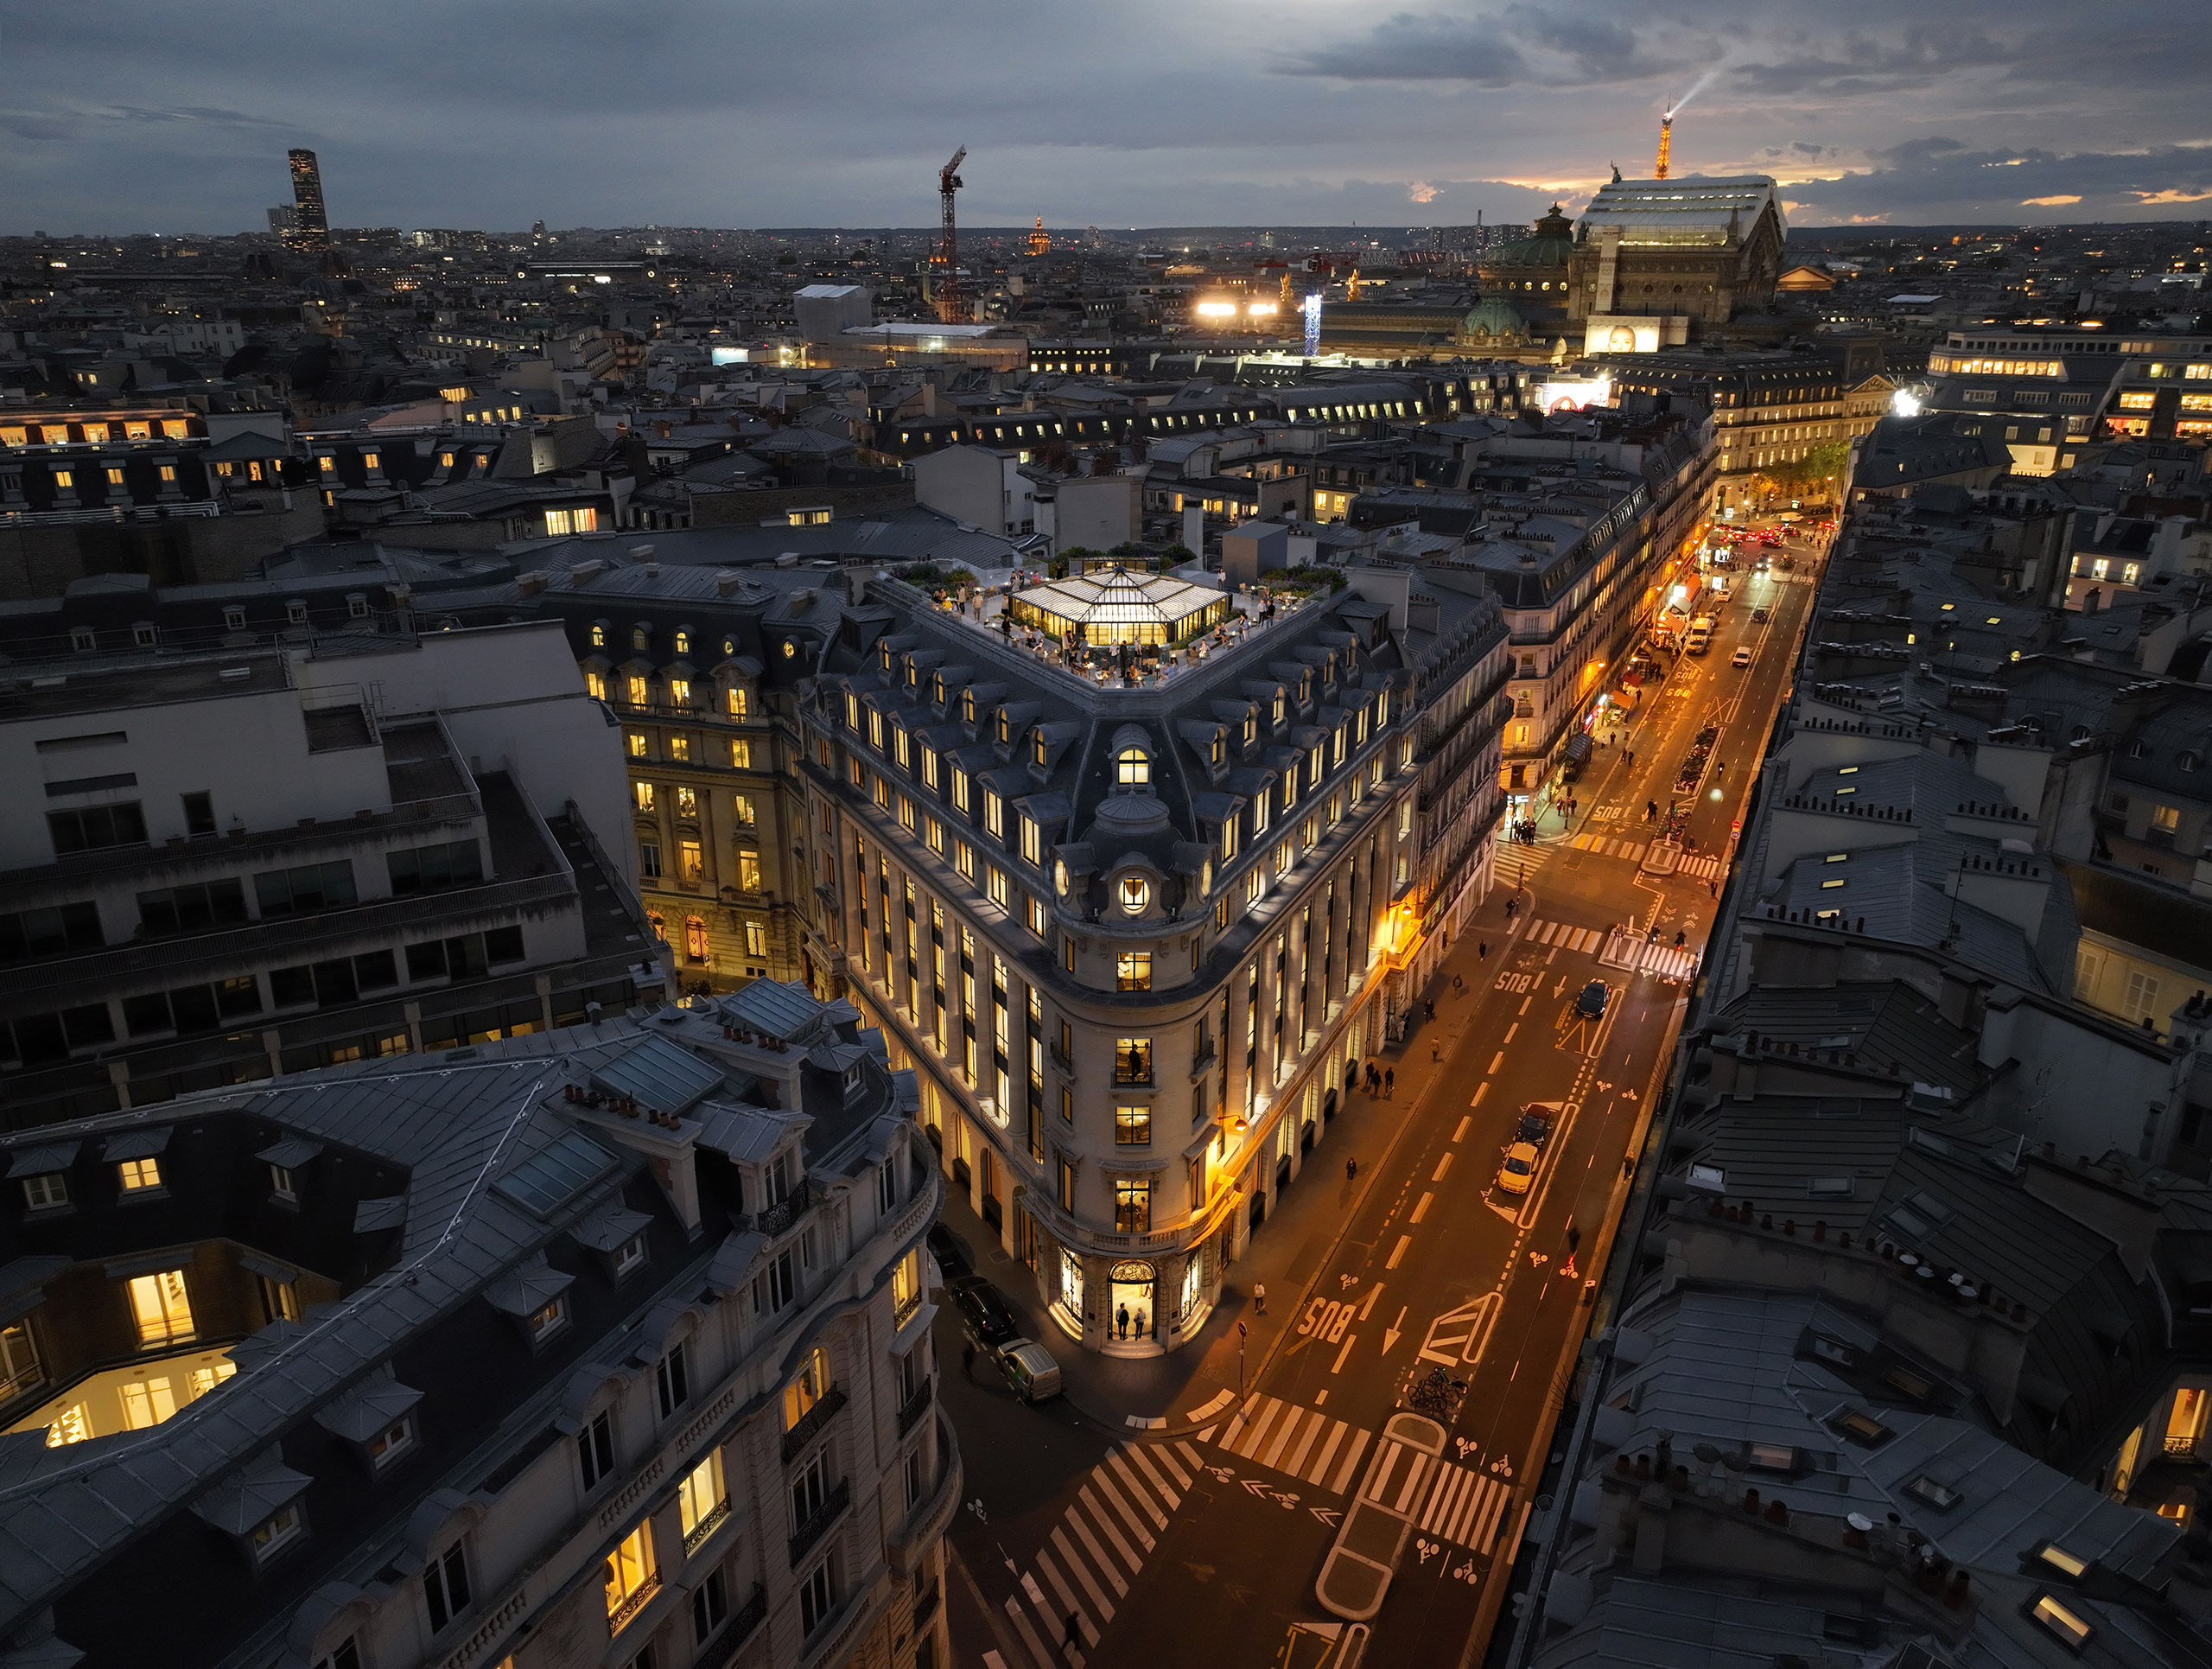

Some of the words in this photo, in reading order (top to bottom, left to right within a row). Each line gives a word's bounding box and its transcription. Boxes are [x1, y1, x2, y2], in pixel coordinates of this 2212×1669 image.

[1675, 671, 1696, 680] BUS
[1666, 688, 1691, 698] BUS
[1593, 806, 1622, 819] BUS
[1494, 971, 1532, 994] BUS
[1298, 1297, 1357, 1344] BUS
